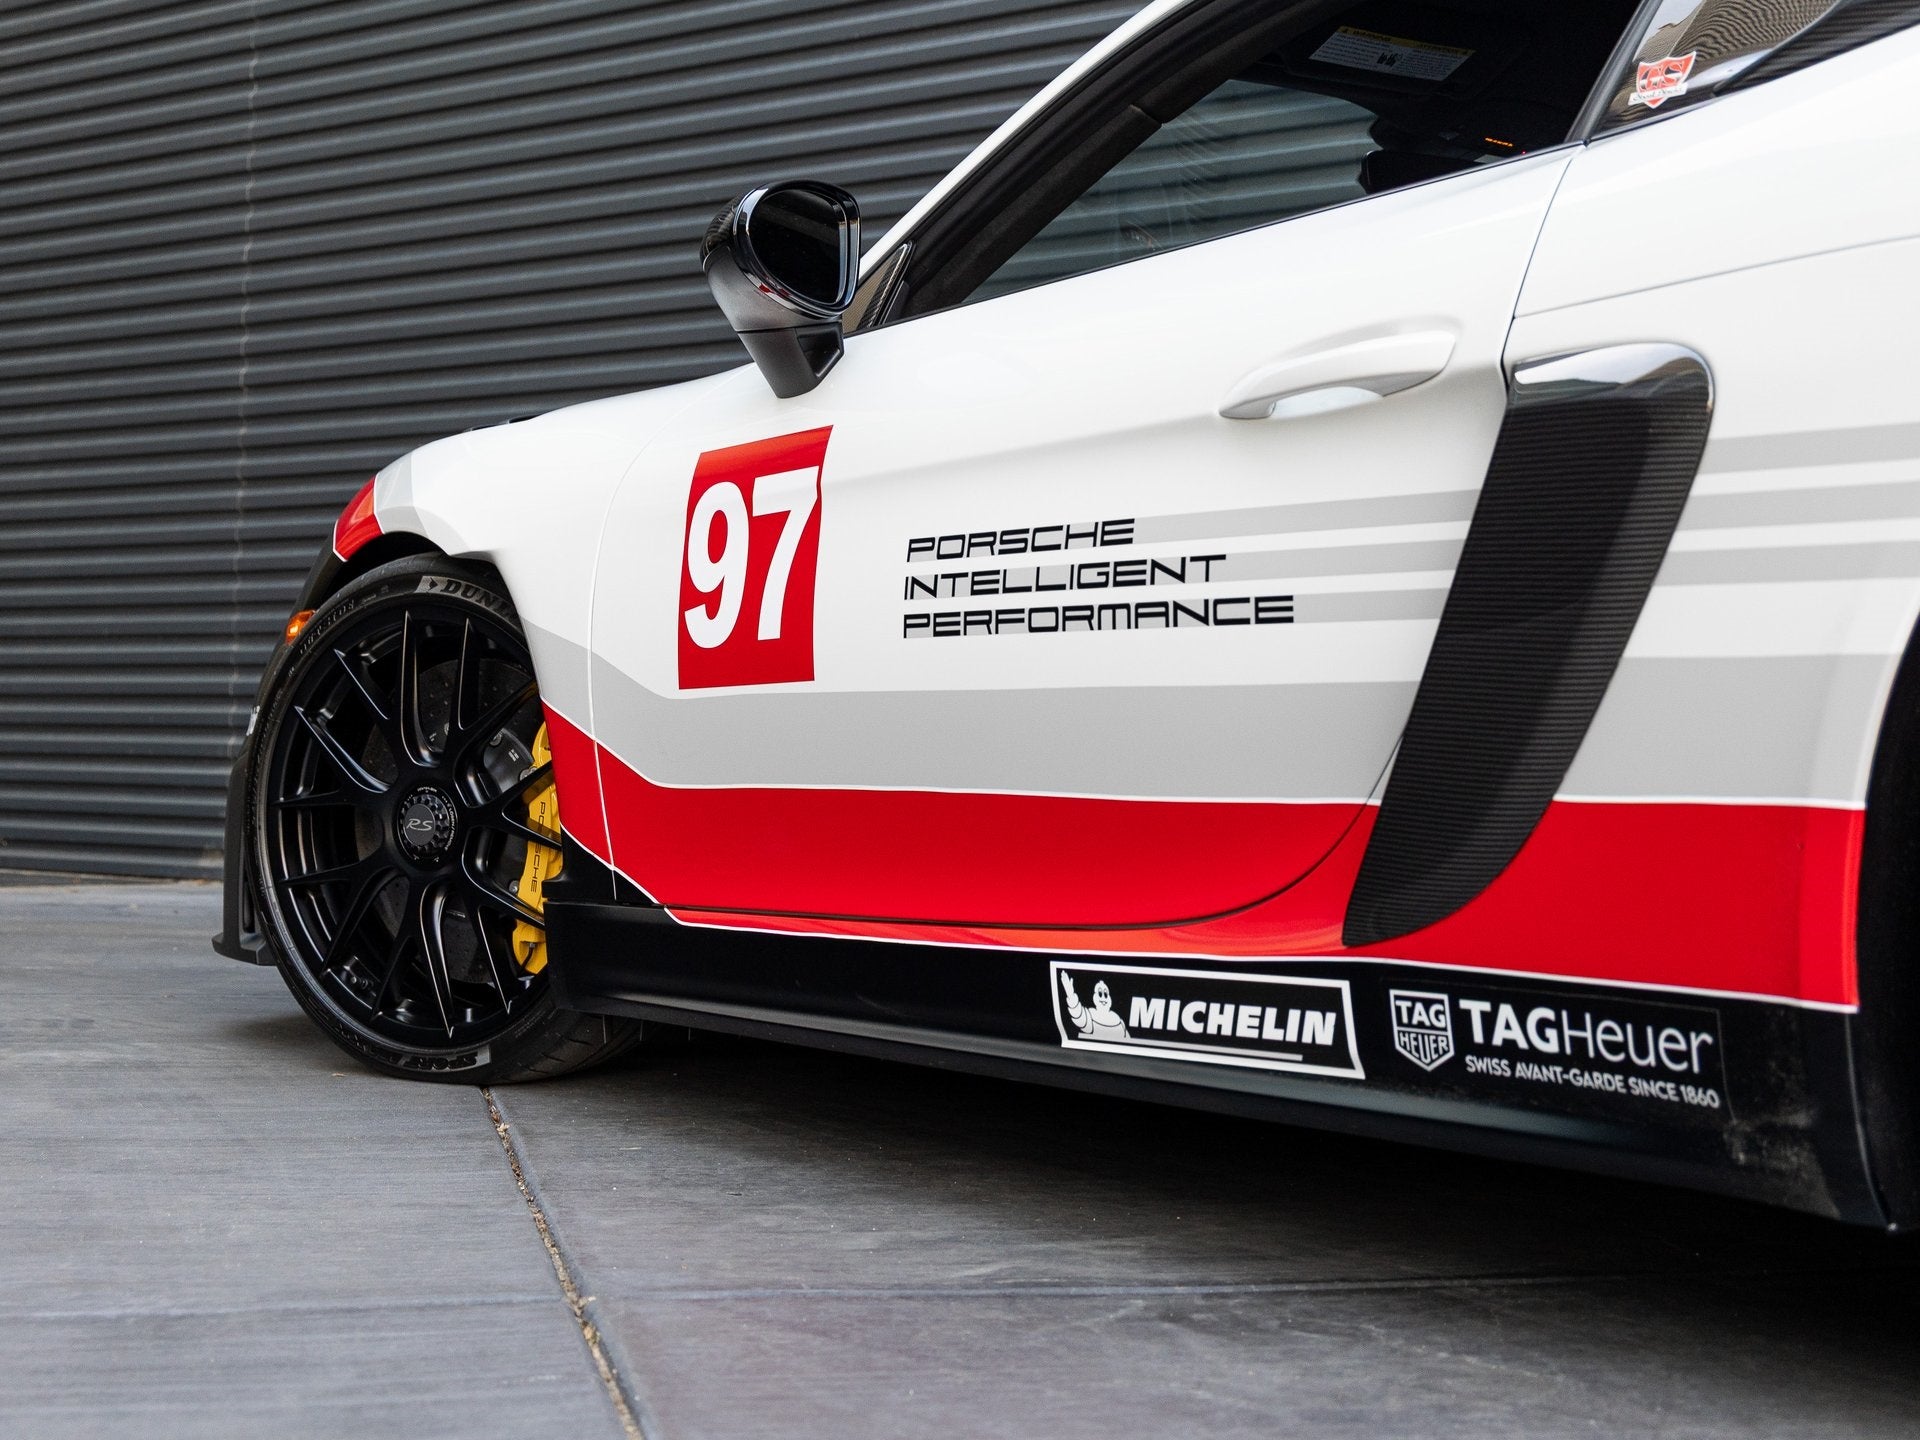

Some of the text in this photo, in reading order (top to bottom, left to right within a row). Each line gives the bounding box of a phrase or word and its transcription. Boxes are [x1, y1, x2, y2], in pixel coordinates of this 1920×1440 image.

[684, 465, 820, 650] 97
[907, 517, 1135, 562] PORSCHE
[904, 554, 1227, 600] INTELLIGENT
[903, 595, 1294, 638] PERFORMANCE
[406, 818, 433, 831] RS
[530, 801, 546, 893] POSCHE
[1128, 996, 1337, 1046] MICHELIN
[1394, 999, 1447, 1029] TAG
[1399, 1031, 1449, 1065] HEUER
[1465, 1054, 1721, 1109] SWISS AVANT-GARDE SINCE 1860
